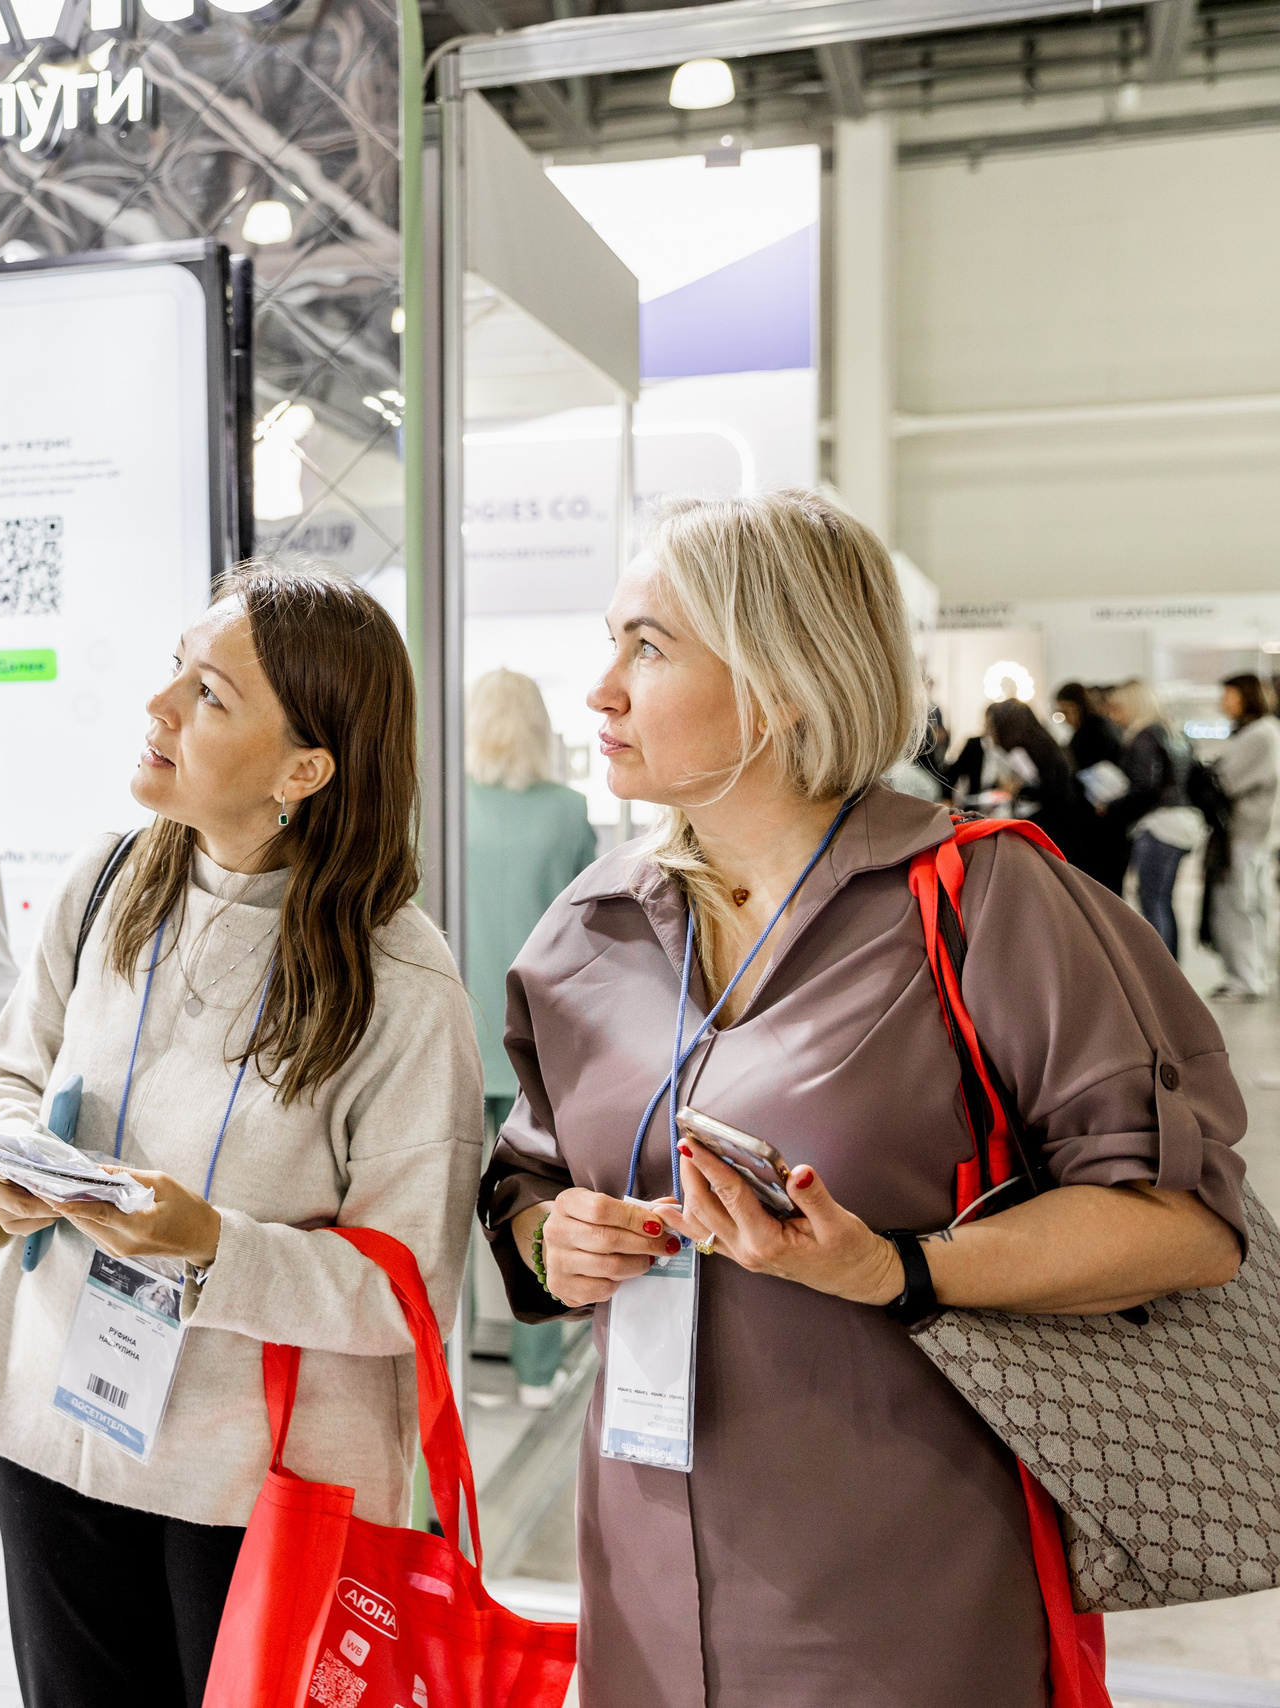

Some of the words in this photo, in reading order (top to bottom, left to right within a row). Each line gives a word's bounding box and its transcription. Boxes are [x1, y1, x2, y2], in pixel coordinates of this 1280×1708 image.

[98, 1333, 140, 1362] НАУЛИНА
[108, 1326, 137, 1347] РУФИНА
[71, 1397, 130, 1436] ПОСЕТИТЕЛЬ
[344, 1589, 397, 1632] АЮНА
[347, 1639, 363, 1657] WB
